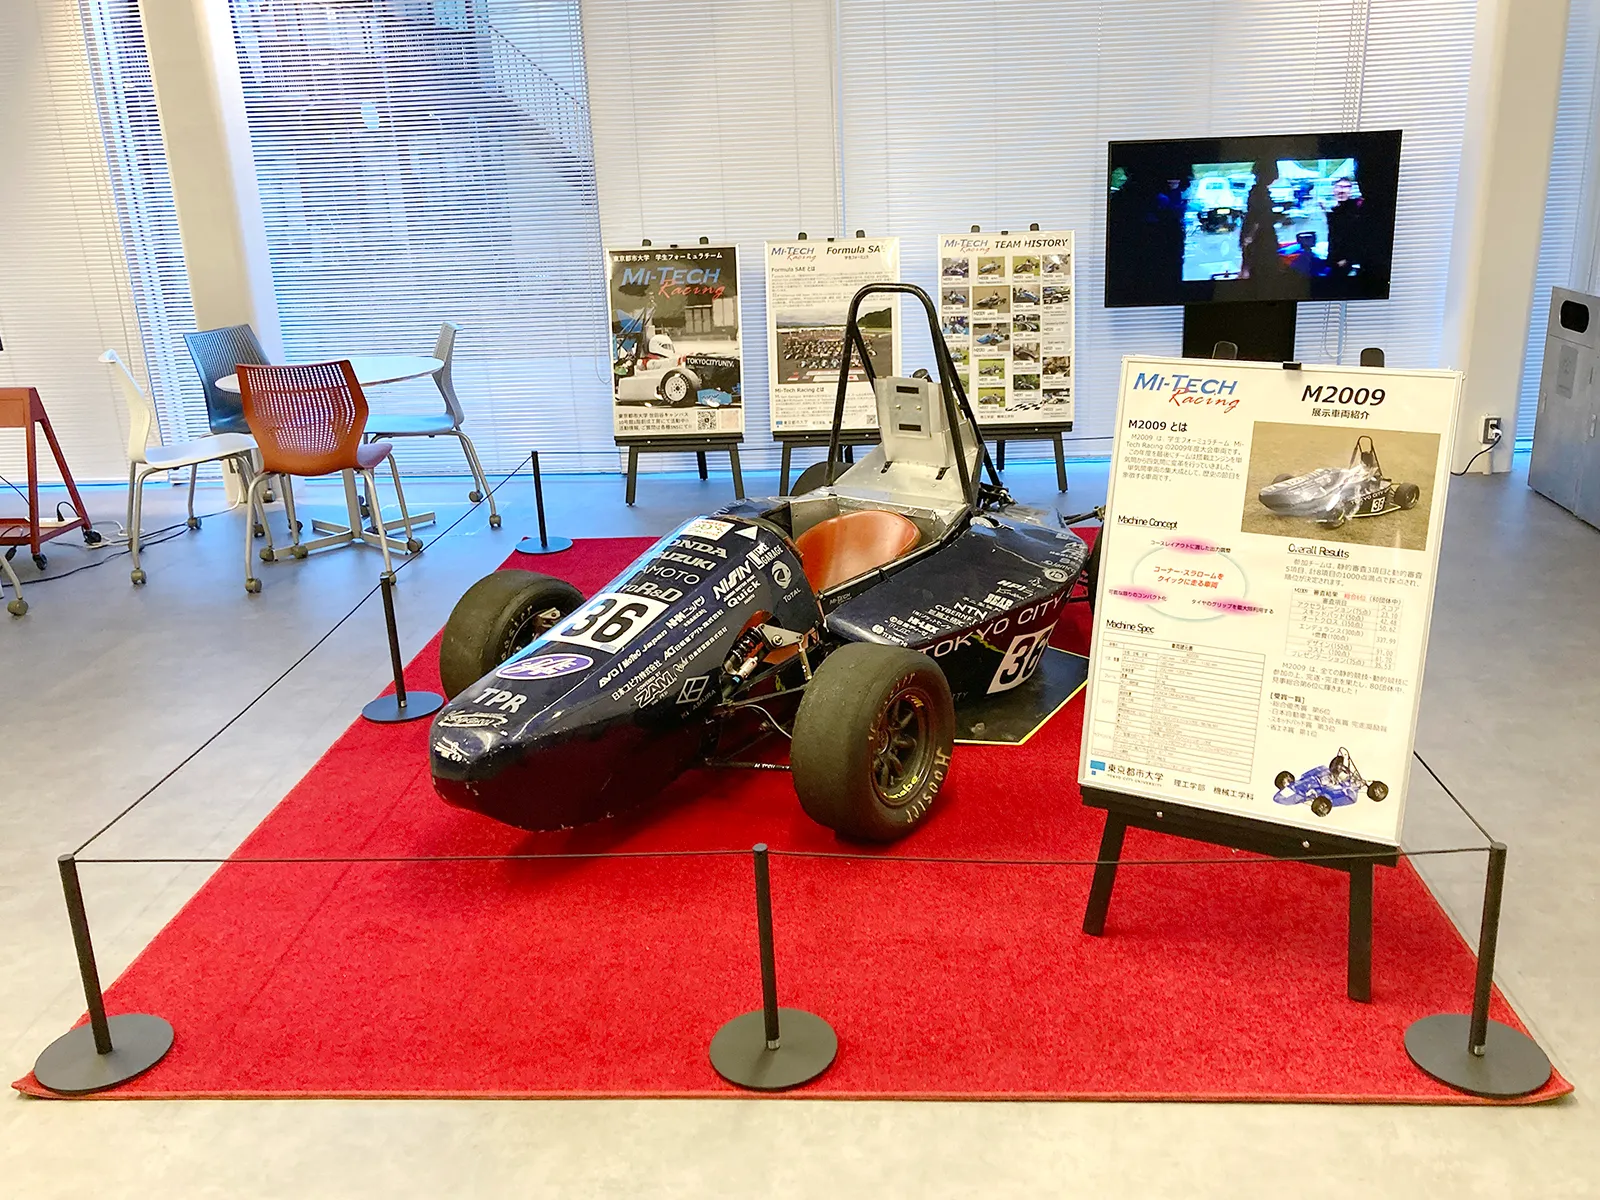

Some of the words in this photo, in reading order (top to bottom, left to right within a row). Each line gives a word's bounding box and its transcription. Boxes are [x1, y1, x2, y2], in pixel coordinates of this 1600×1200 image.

[826, 245, 865, 256] Formula
[994, 240, 1021, 249] TEAM
[1024, 238, 1069, 248] HISTORY
[613, 254, 650, 263] 東京都市大学
[658, 278, 726, 301] Racing
[1168, 387, 1241, 414] Racing
[1301, 384, 1387, 406] M2009
[1311, 407, 1371, 420] 展示車両紹介
[1128, 419, 1167, 431] M2009
[1169, 421, 1188, 433] とは
[1126, 440, 1141, 449] Tech
[1142, 442, 1163, 451] Racing
[1131, 433, 1154, 442] M2009
[760, 544, 785, 565] GARAGE
[1318, 546, 1350, 560] Results
[712, 559, 753, 601] NISIN
[727, 579, 762, 609] Quick
[782, 587, 803, 604] TOTAL
[560, 597, 649, 643] 36
[953, 601, 989, 621] NTN
[917, 617, 1011, 657] TOKYO
[1017, 590, 1066, 625] CITY
[642, 629, 669, 654] Japan
[1281, 661, 1307, 672] M2009
[472, 687, 529, 714] TPR
[1107, 763, 1165, 782] 東京都市大学
